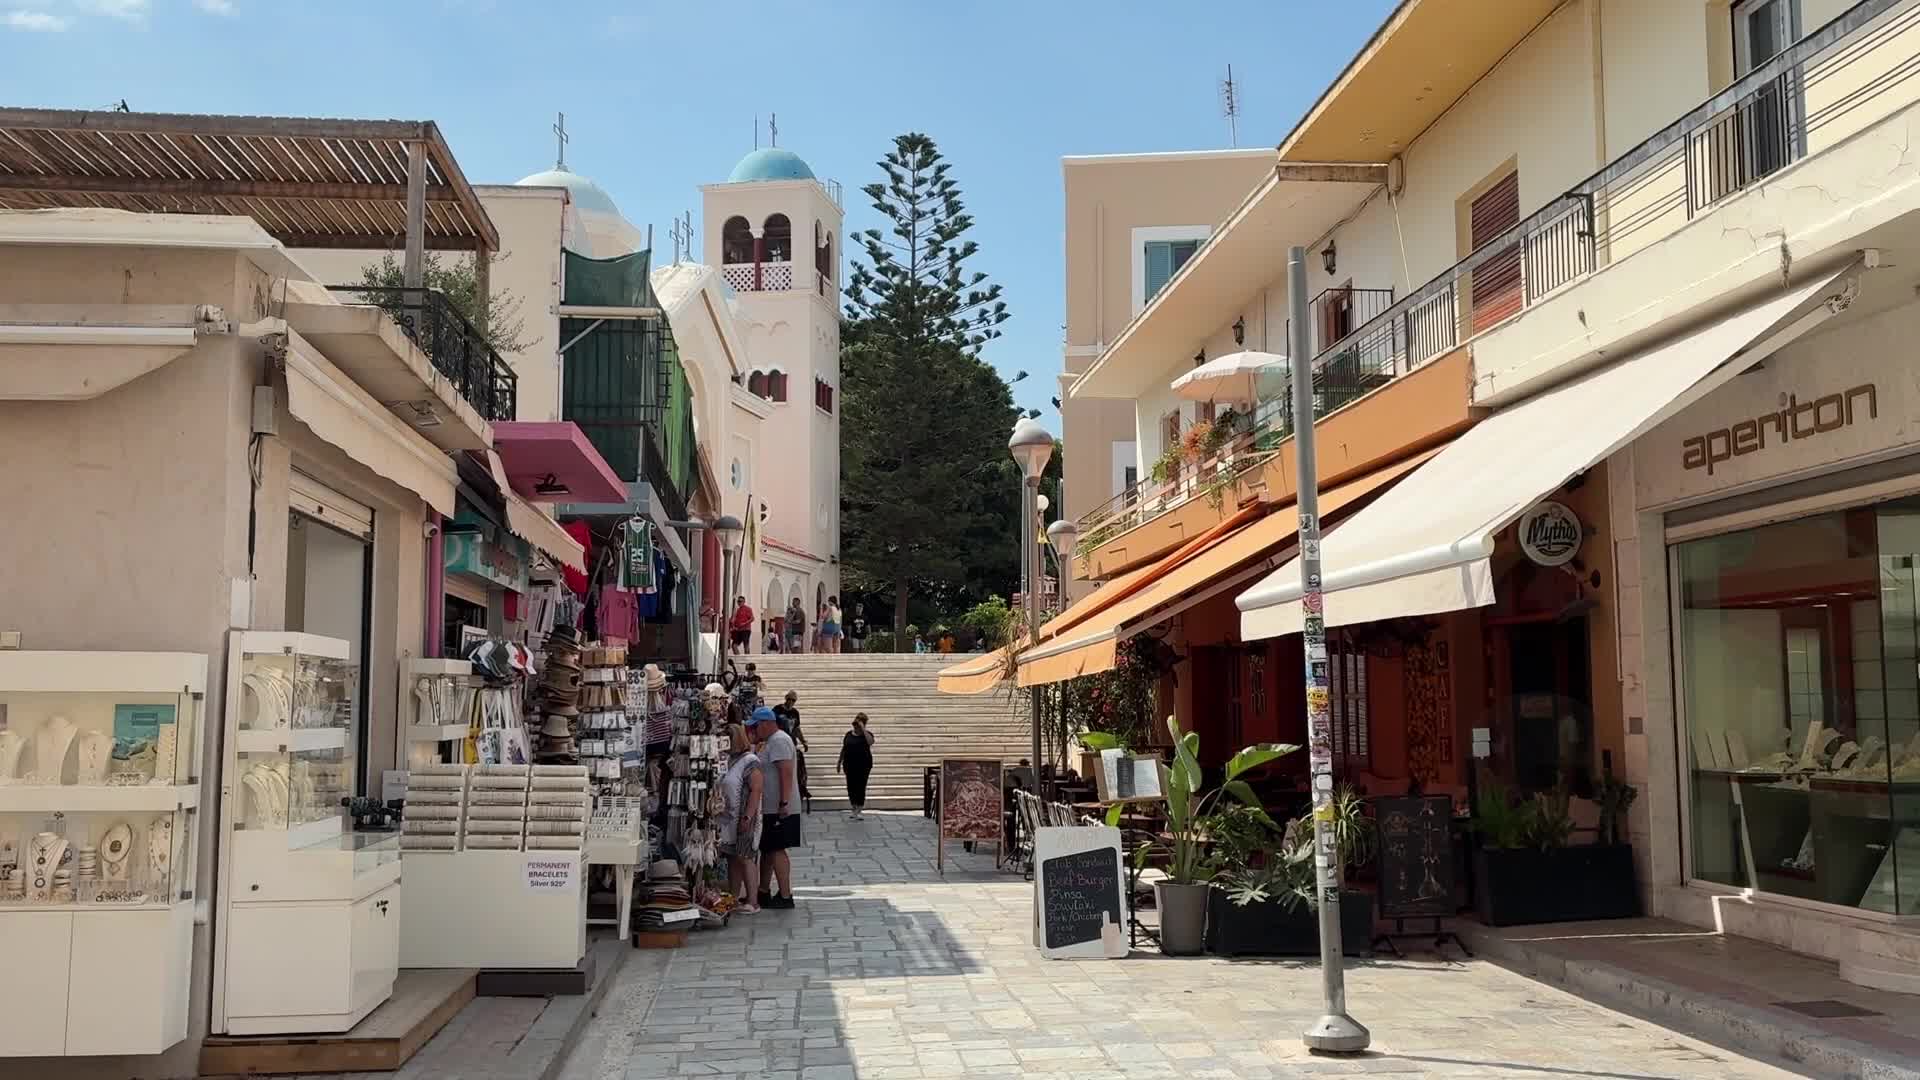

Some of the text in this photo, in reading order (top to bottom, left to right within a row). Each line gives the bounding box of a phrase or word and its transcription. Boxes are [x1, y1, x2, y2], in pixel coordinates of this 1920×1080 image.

[1683, 383, 1877, 475] aperiton
[631, 548, 644, 562] 25
[1077, 873, 1114, 891] Burger
